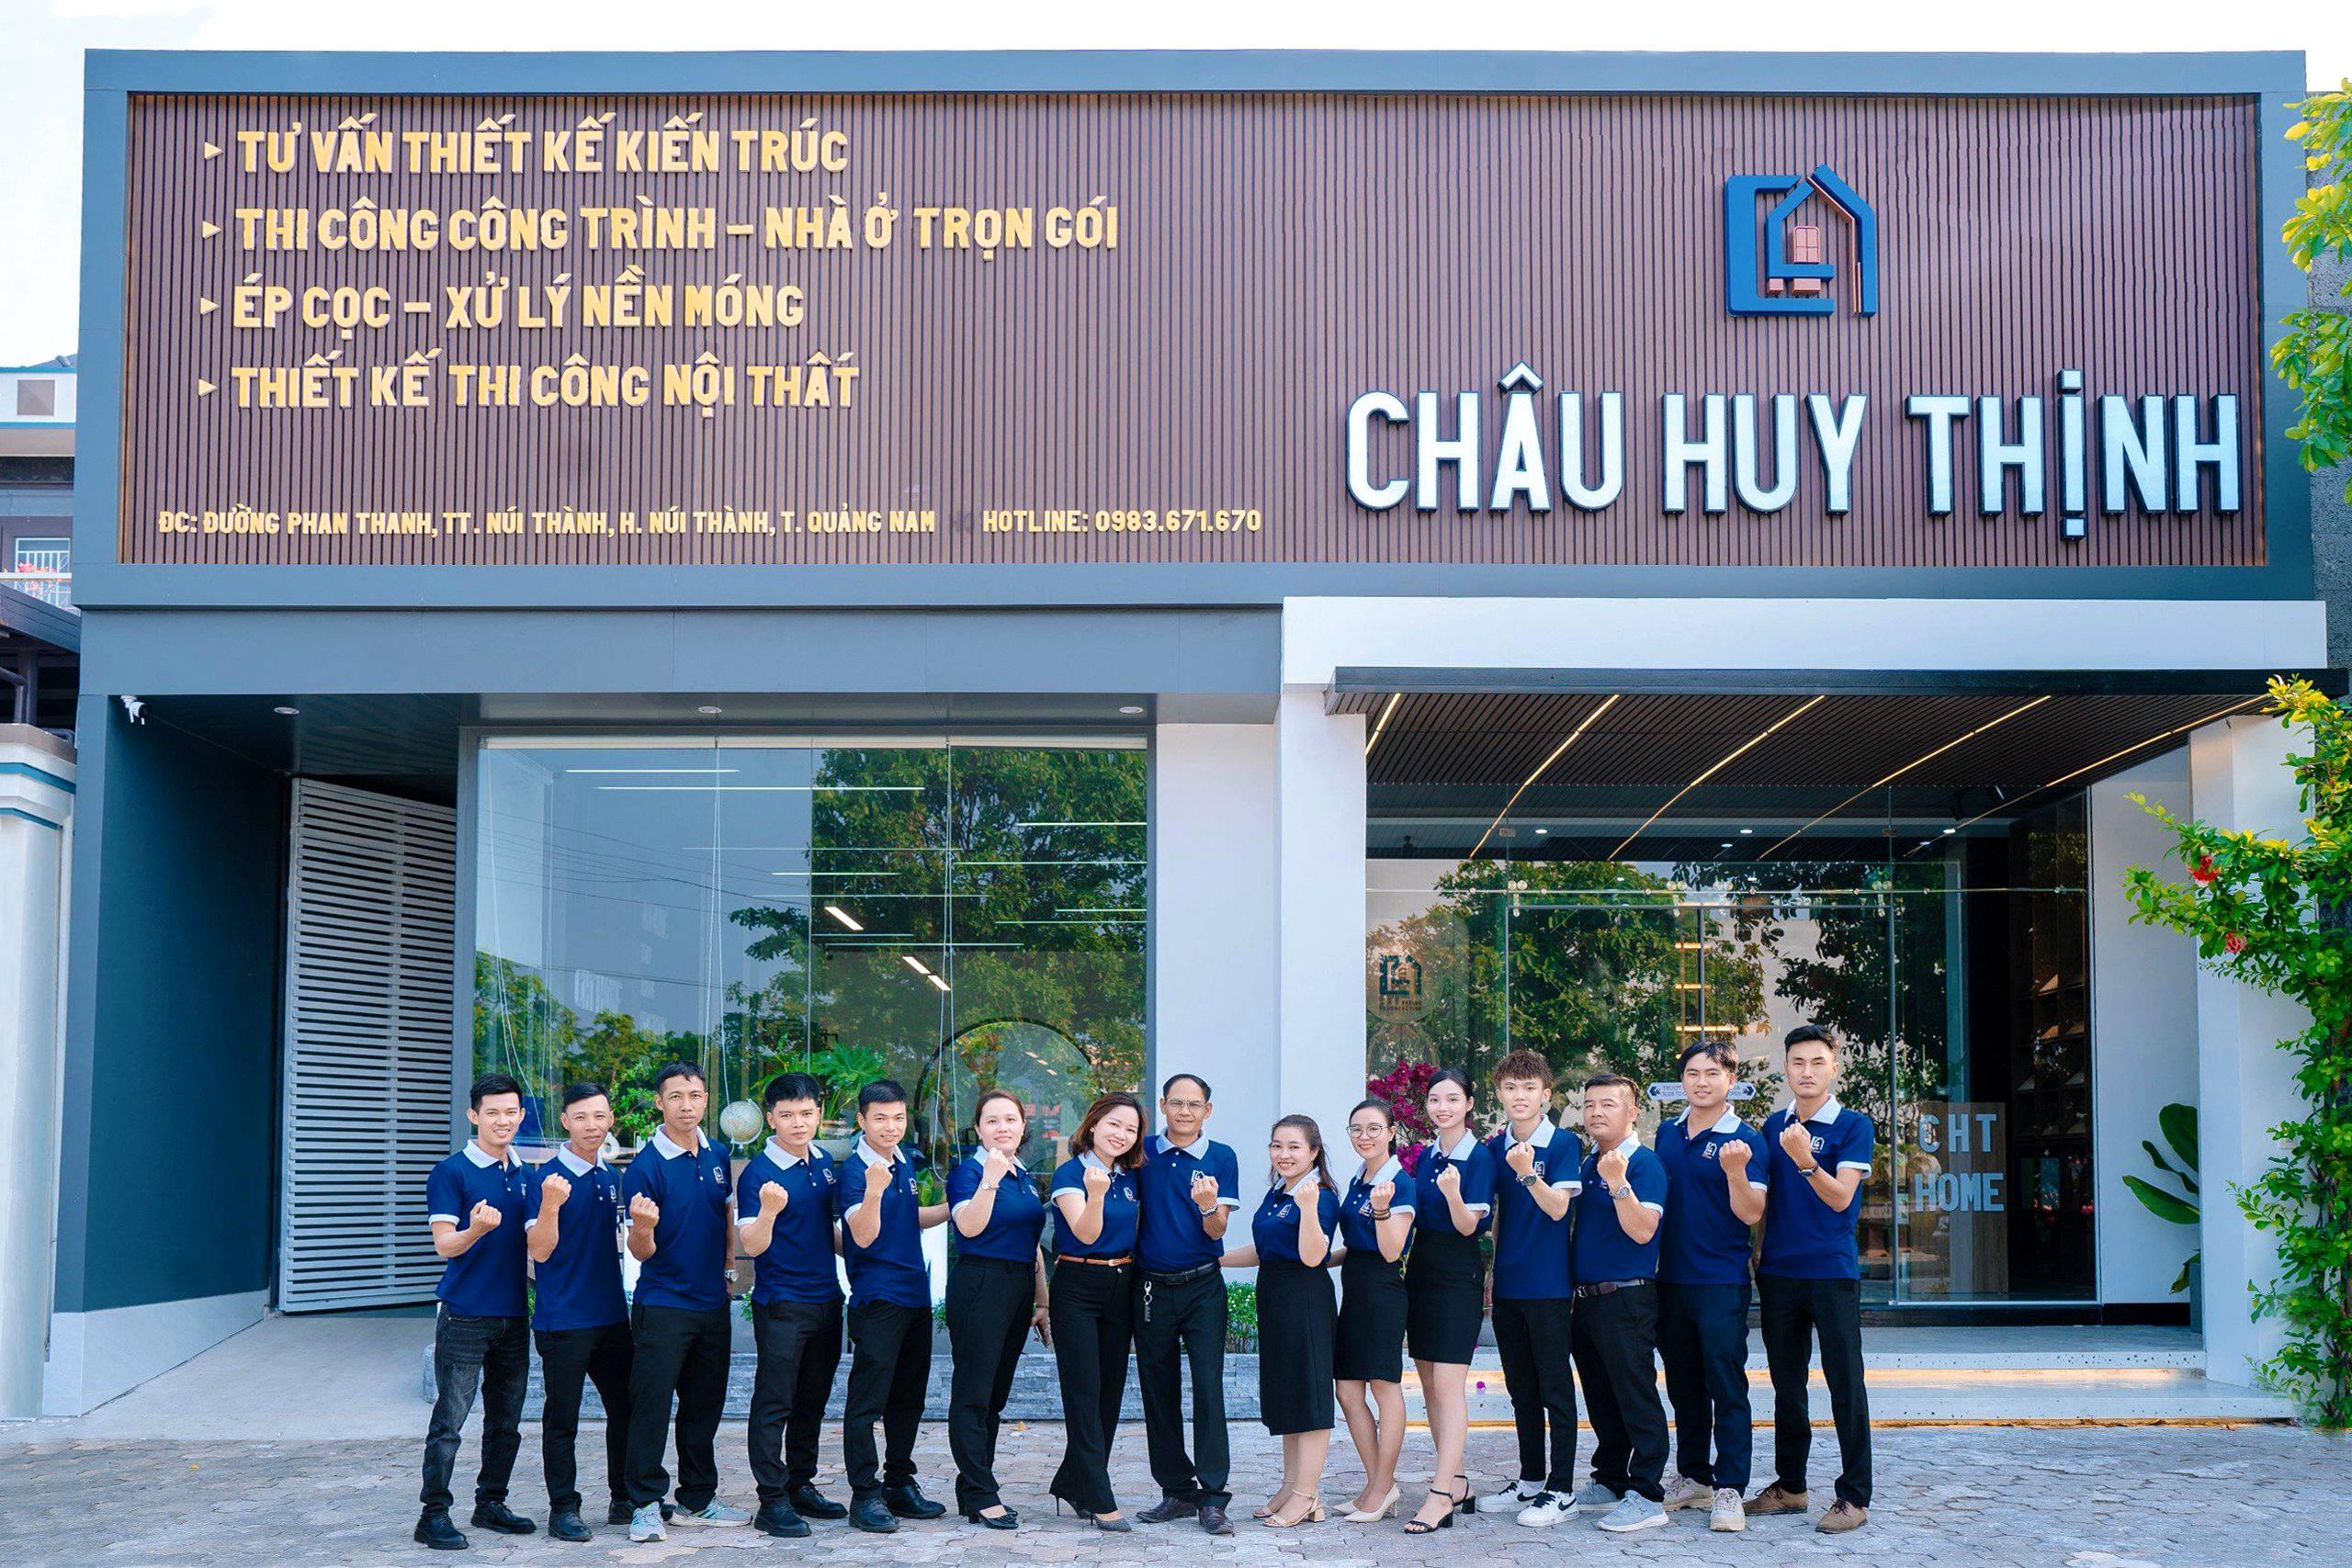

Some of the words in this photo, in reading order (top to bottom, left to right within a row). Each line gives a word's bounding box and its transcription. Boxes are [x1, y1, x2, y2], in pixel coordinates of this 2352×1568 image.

[237, 121, 301, 174] TƯ
[311, 112, 393, 174] VẤN
[401, 114, 532, 174] THIẾT
[543, 112, 617, 174] KẾ
[616, 111, 719, 174] KIẾN
[731, 118, 849, 173] TRÚC
[235, 208, 309, 251] THI
[318, 196, 439, 251] CÔNG
[448, 196, 568, 251] CÔNG
[579, 195, 716, 251] TRÌNH
[764, 194, 853, 249] NHÀ
[865, 191, 899, 249] Ở
[913, 207, 1033, 261] TRỌN
[1045, 195, 1118, 249] GÓI
[233, 272, 293, 328] ÉP
[302, 286, 391, 341] CỌC
[446, 270, 510, 329] XỬ
[518, 272, 571, 329] LÝ
[582, 265, 673, 328] NỀN
[684, 273, 804, 328] MÓNG
[231, 349, 359, 408] THIẾT
[370, 347, 444, 407] KẾ
[448, 365, 521, 407] THI
[530, 352, 650, 407] CÔNG
[663, 351, 735, 419] NỘI
[746, 351, 860, 408] THẤT
[1345, 360, 1623, 513] CHÂU
[1662, 392, 1869, 514] HUY
[158, 511, 198, 534] ĐC:
[202, 503, 280, 535] ĐƯỜNG
[287, 512, 348, 535] PHAN
[355, 512, 438, 538] THANH,
[442, 512, 481, 535] TT.
[486, 505, 524, 535] NÚI
[531, 505, 615, 538] THÀNH,
[619, 512, 642, 535] H.
[649, 505, 686, 535] NÚI
[693, 505, 775, 536] THÀNH,
[780, 511, 802, 534] T.
[807, 502, 882, 533] QUẢNG
[888, 510, 935, 533] NAM
[982, 510, 1089, 533] HOTLINE:
[1095, 510, 1261, 533] 0983.671.670
[1915, 1172, 2005, 1212] HOME
